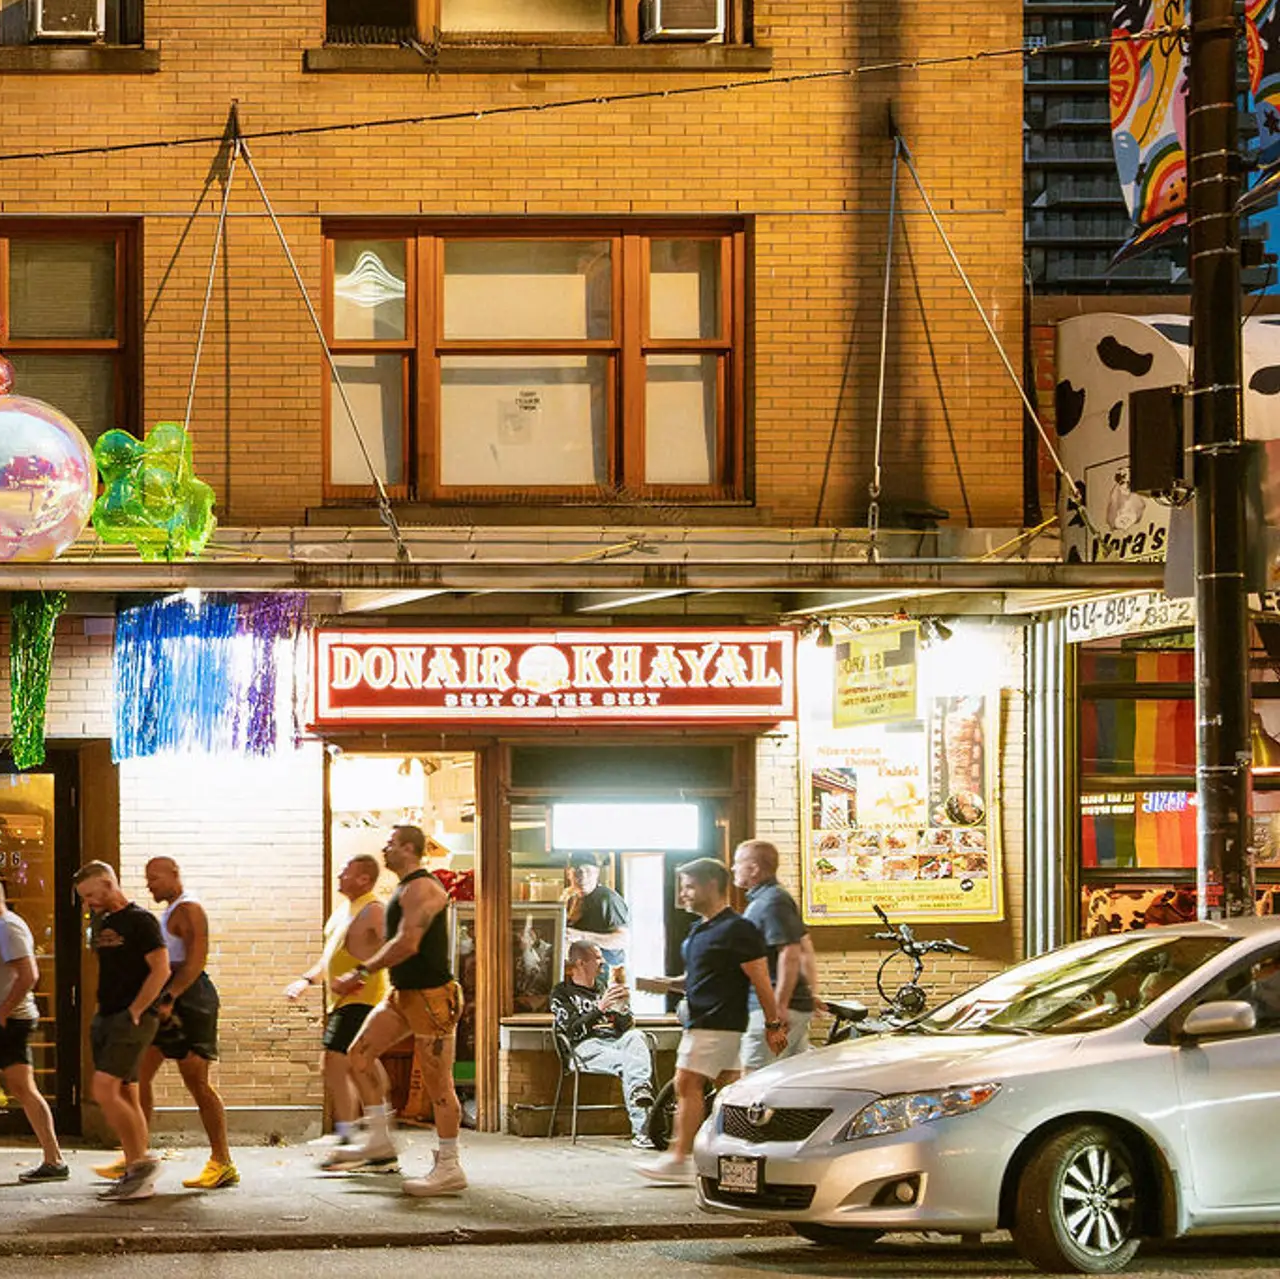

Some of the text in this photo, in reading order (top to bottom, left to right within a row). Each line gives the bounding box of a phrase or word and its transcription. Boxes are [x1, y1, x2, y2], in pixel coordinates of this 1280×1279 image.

[331, 641, 782, 690] DONAIR KHAYAL
[444, 692, 661, 706] BEST OF THE BEST
